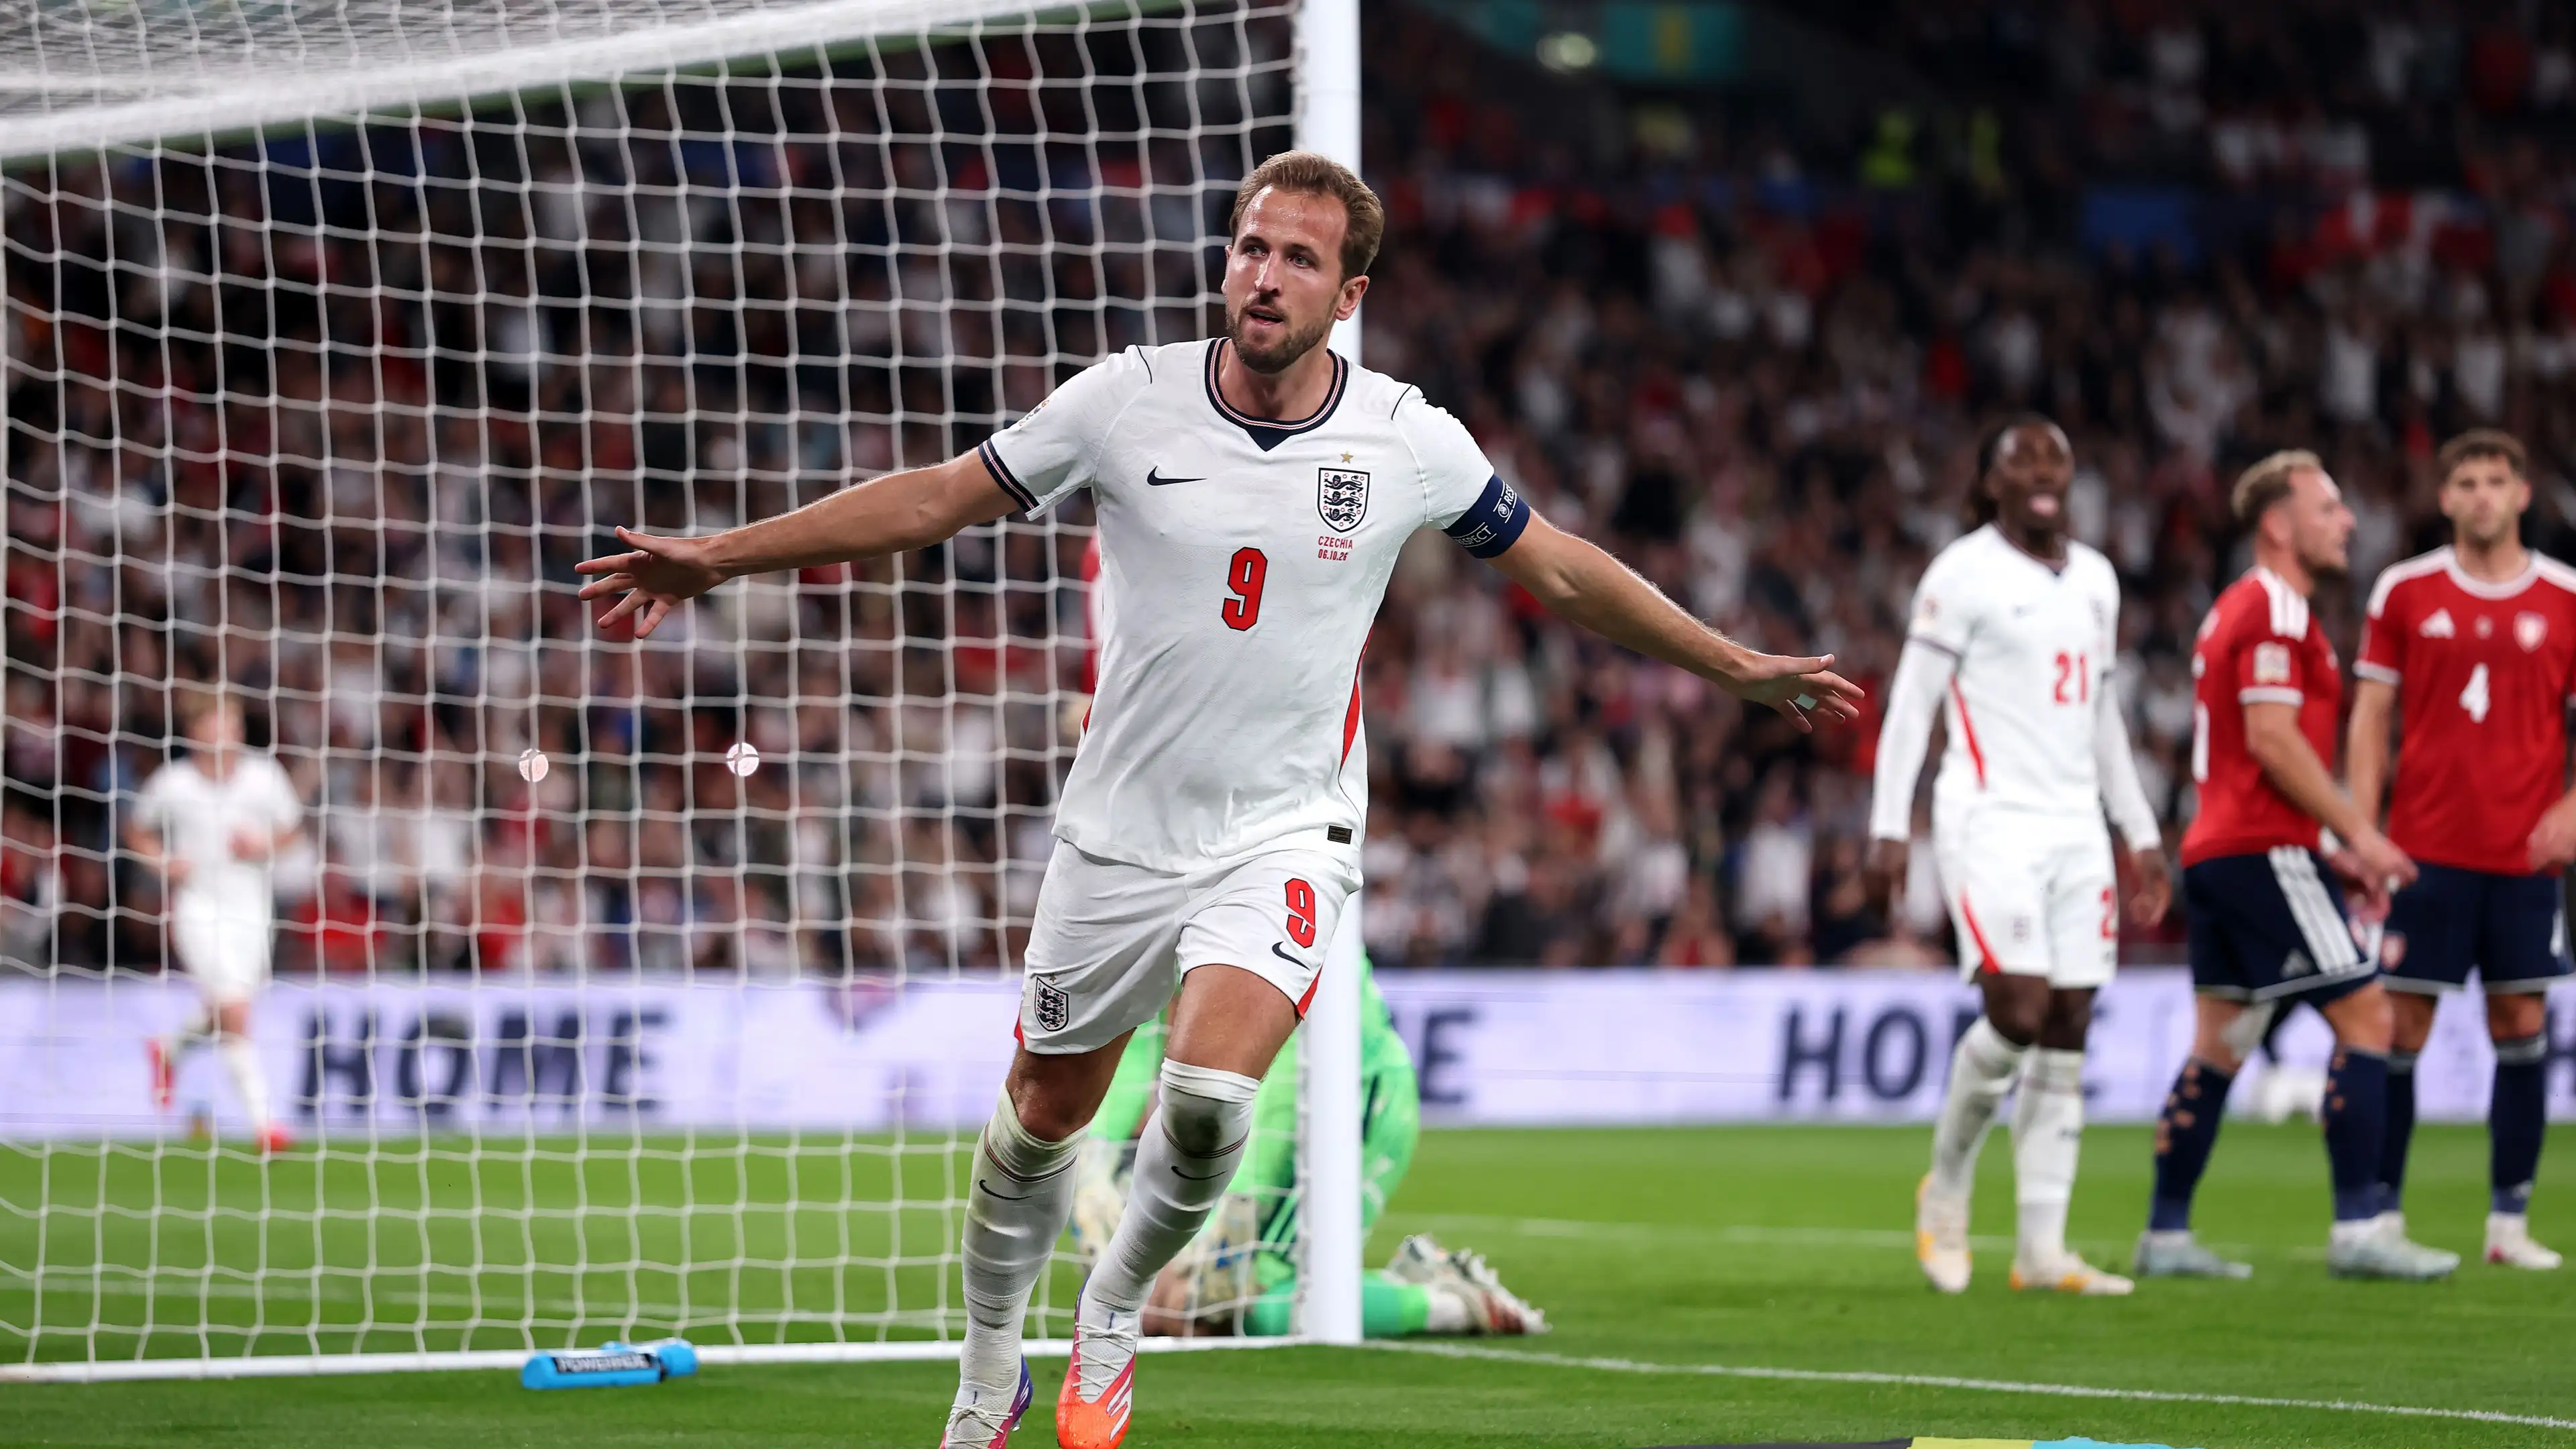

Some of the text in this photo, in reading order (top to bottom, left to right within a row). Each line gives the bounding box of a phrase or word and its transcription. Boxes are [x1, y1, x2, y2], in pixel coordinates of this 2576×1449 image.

[1318, 536, 1352, 549] CZECHIA
[1318, 549, 1348, 561] 06.10.26
[1222, 547, 1267, 631] 9
[2053, 651, 2088, 704] 21
[2459, 662, 2490, 723] 4
[1285, 878, 1316, 948] 9
[300, 1008, 667, 1113] HOME
[1780, 1008, 2109, 1101] HO
